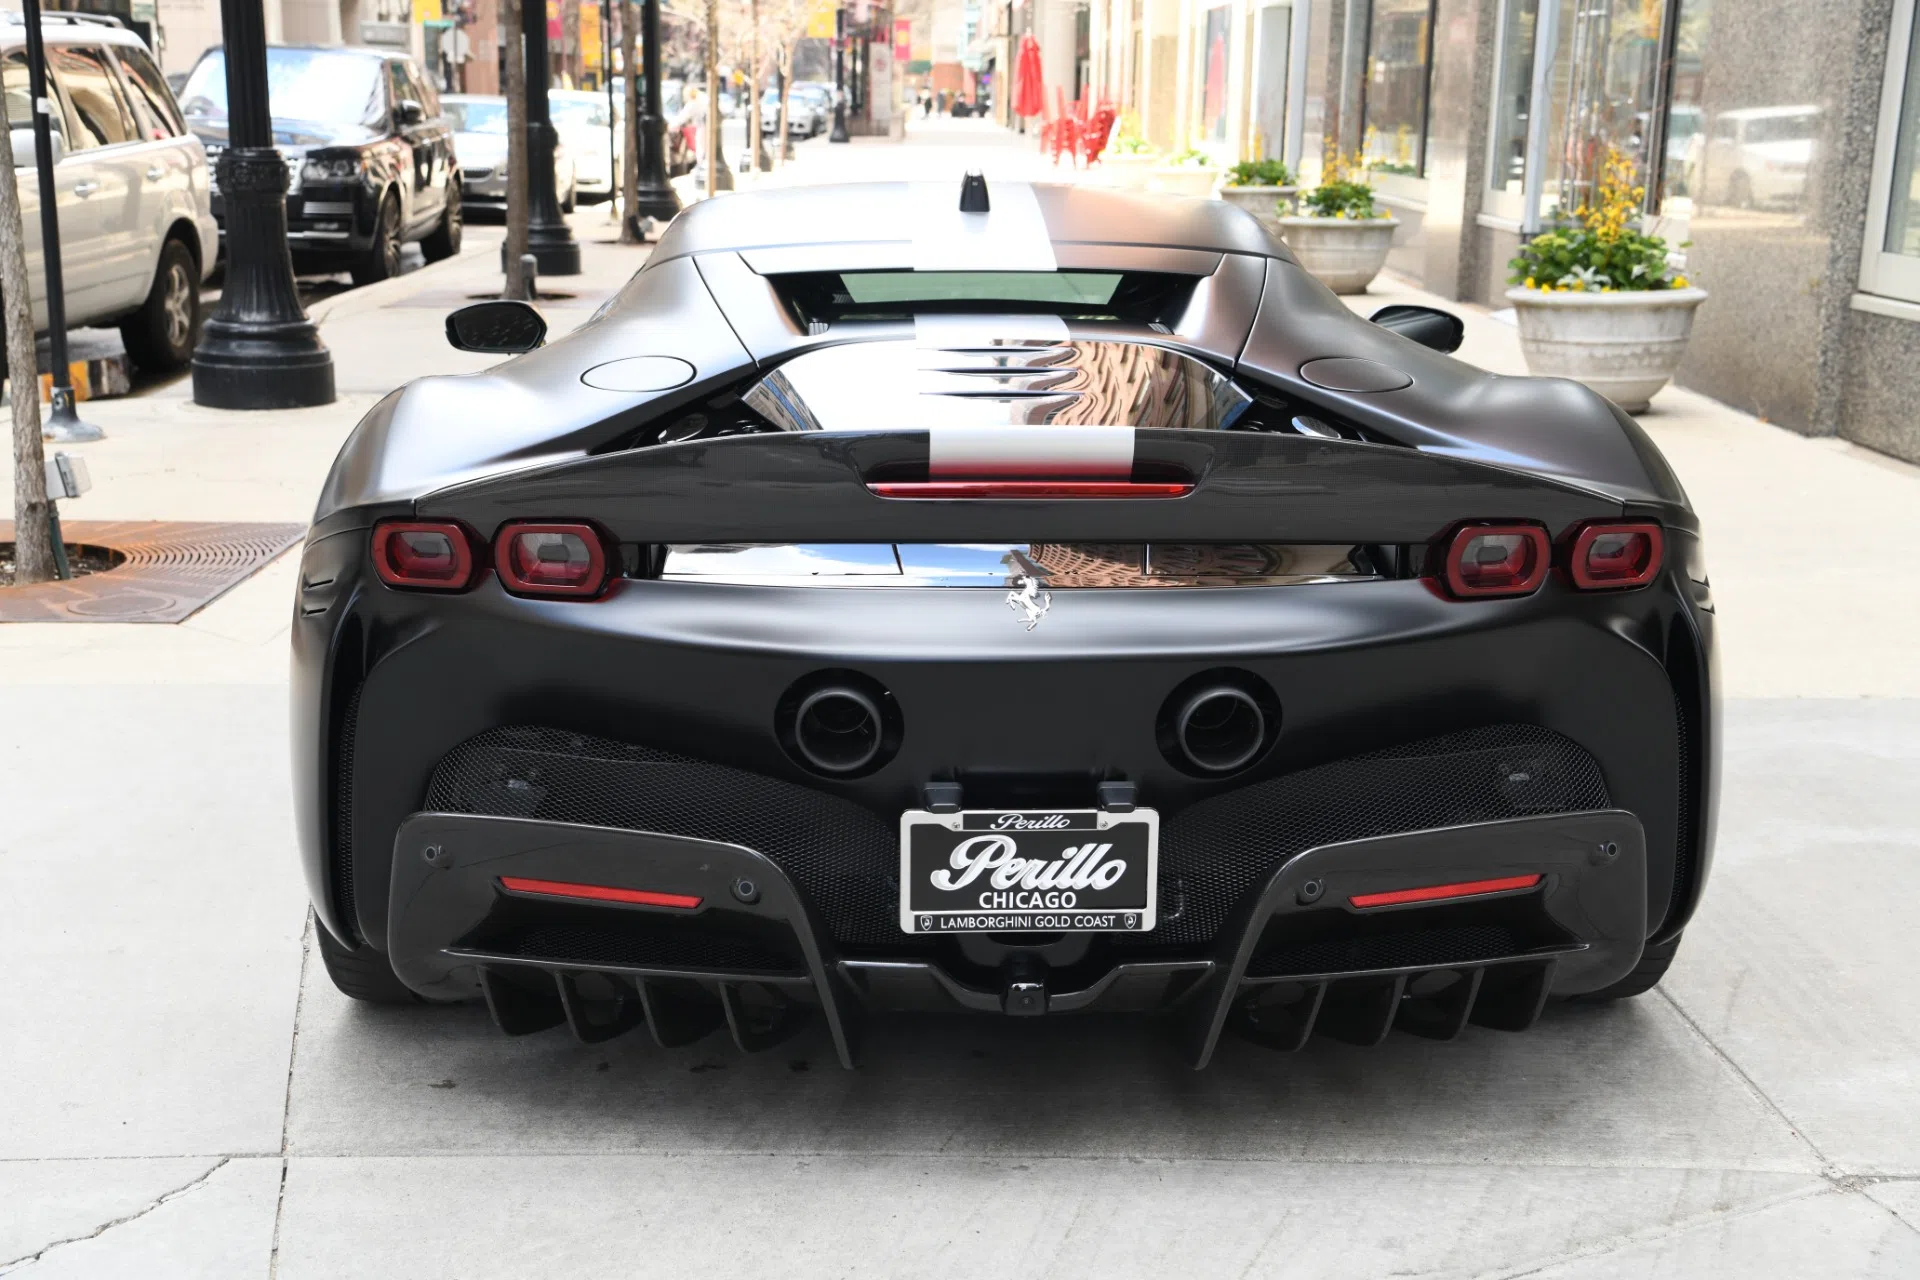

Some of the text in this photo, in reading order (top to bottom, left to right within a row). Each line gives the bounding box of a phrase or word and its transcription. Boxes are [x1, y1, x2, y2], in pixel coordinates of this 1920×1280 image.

[990, 813, 1071, 830] Perillo
[930, 834, 1127, 891] Perillo
[979, 891, 1077, 909] CHICAGO
[940, 915, 1116, 929] LAMBORGHINI GOLD COAST
